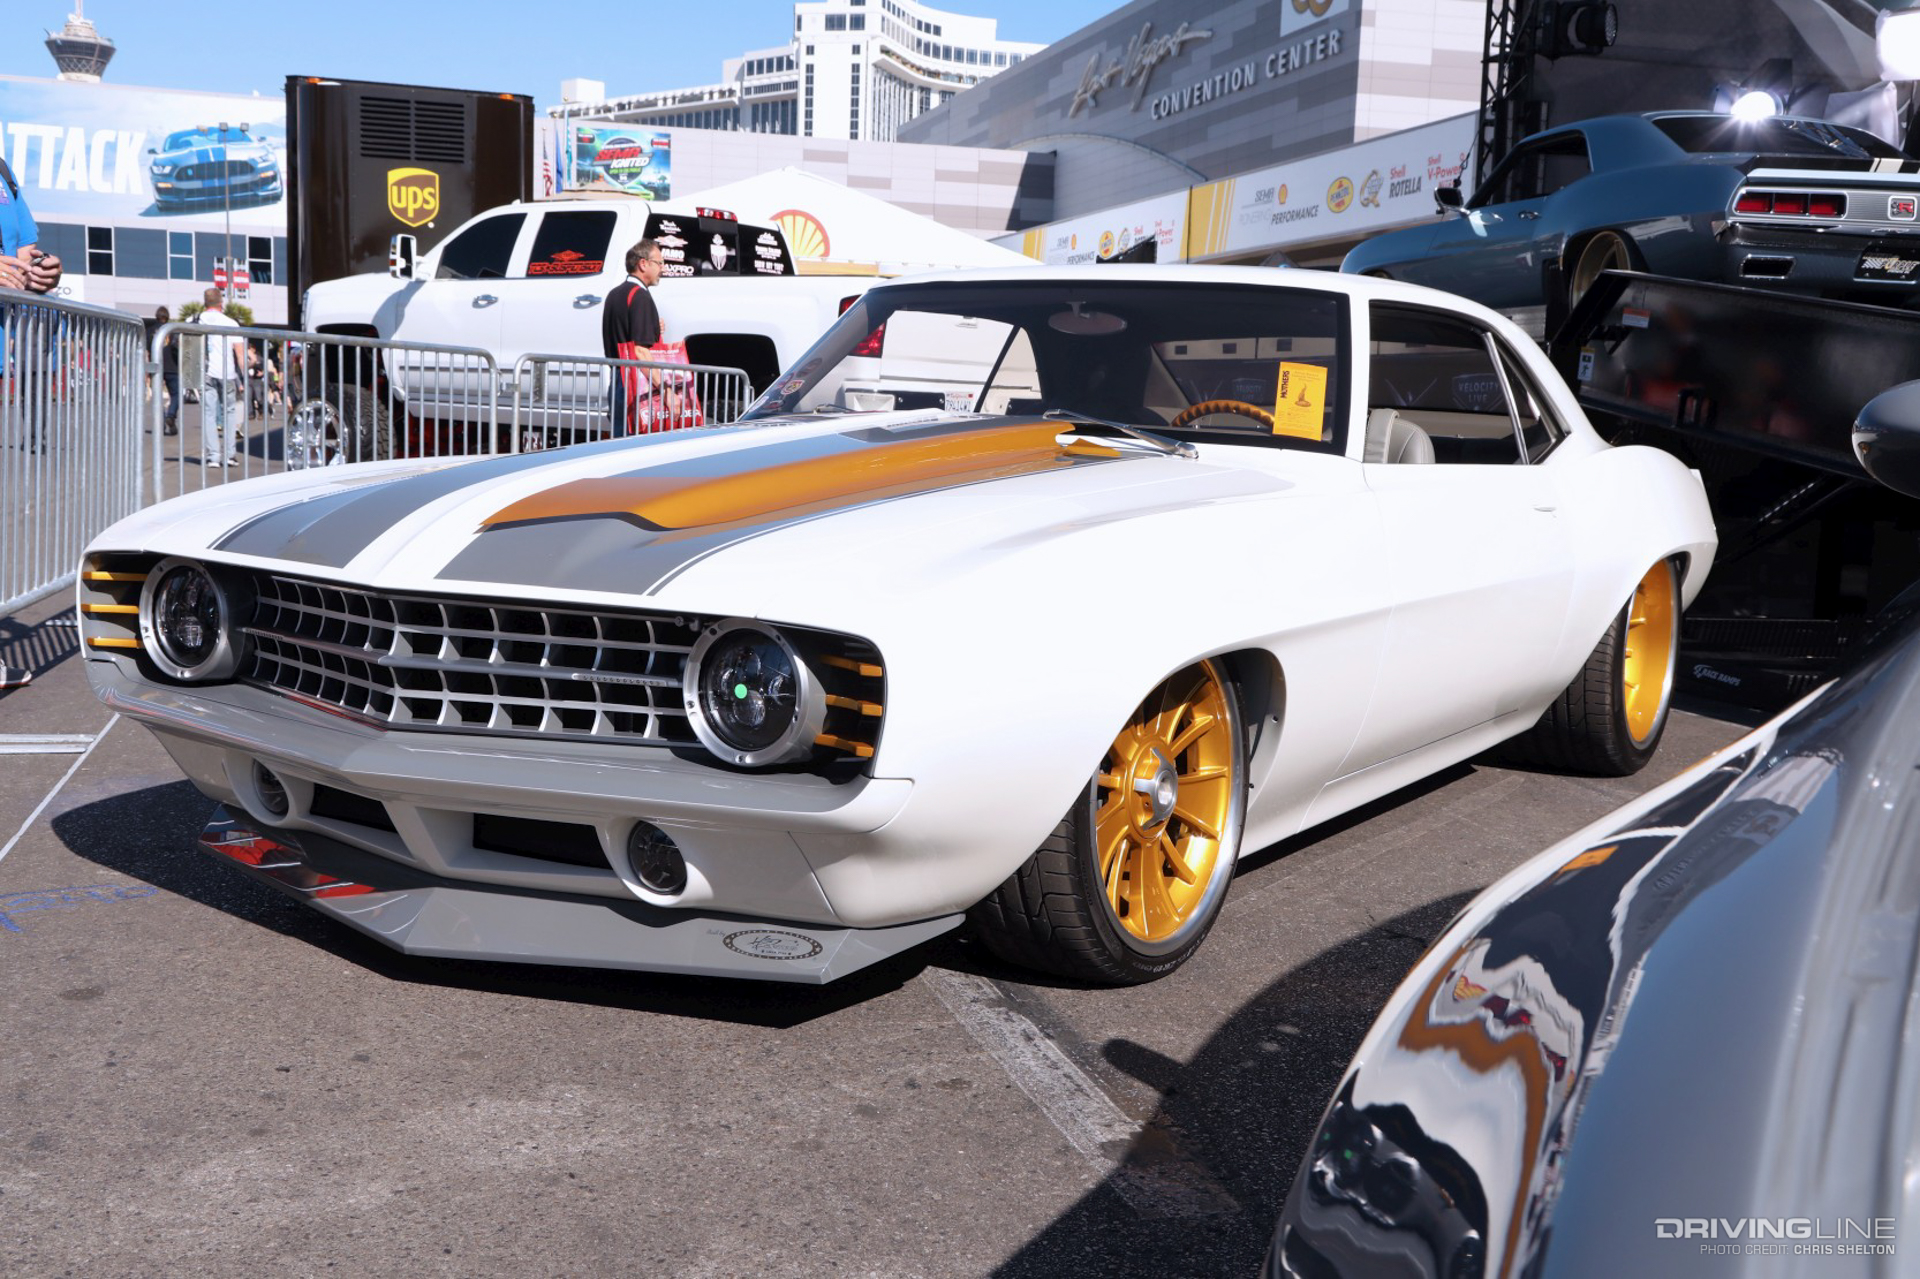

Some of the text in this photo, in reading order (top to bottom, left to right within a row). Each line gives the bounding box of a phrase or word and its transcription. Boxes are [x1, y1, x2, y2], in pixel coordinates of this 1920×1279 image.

[1150, 29, 1342, 121] CONVENTION CENTER
[0, 122, 147, 196] TTACK
[611, 156, 650, 168] IGNITED
[1390, 164, 1406, 180] Shell
[1389, 176, 1422, 198] ROTELLA
[391, 185, 436, 218] ups
[1271, 205, 1319, 225] PERFORMANCE
[1280, 370, 1289, 399] MOTHERS
[1458, 382, 1499, 392] VELOCITY
[1468, 394, 1488, 403] LIVE
